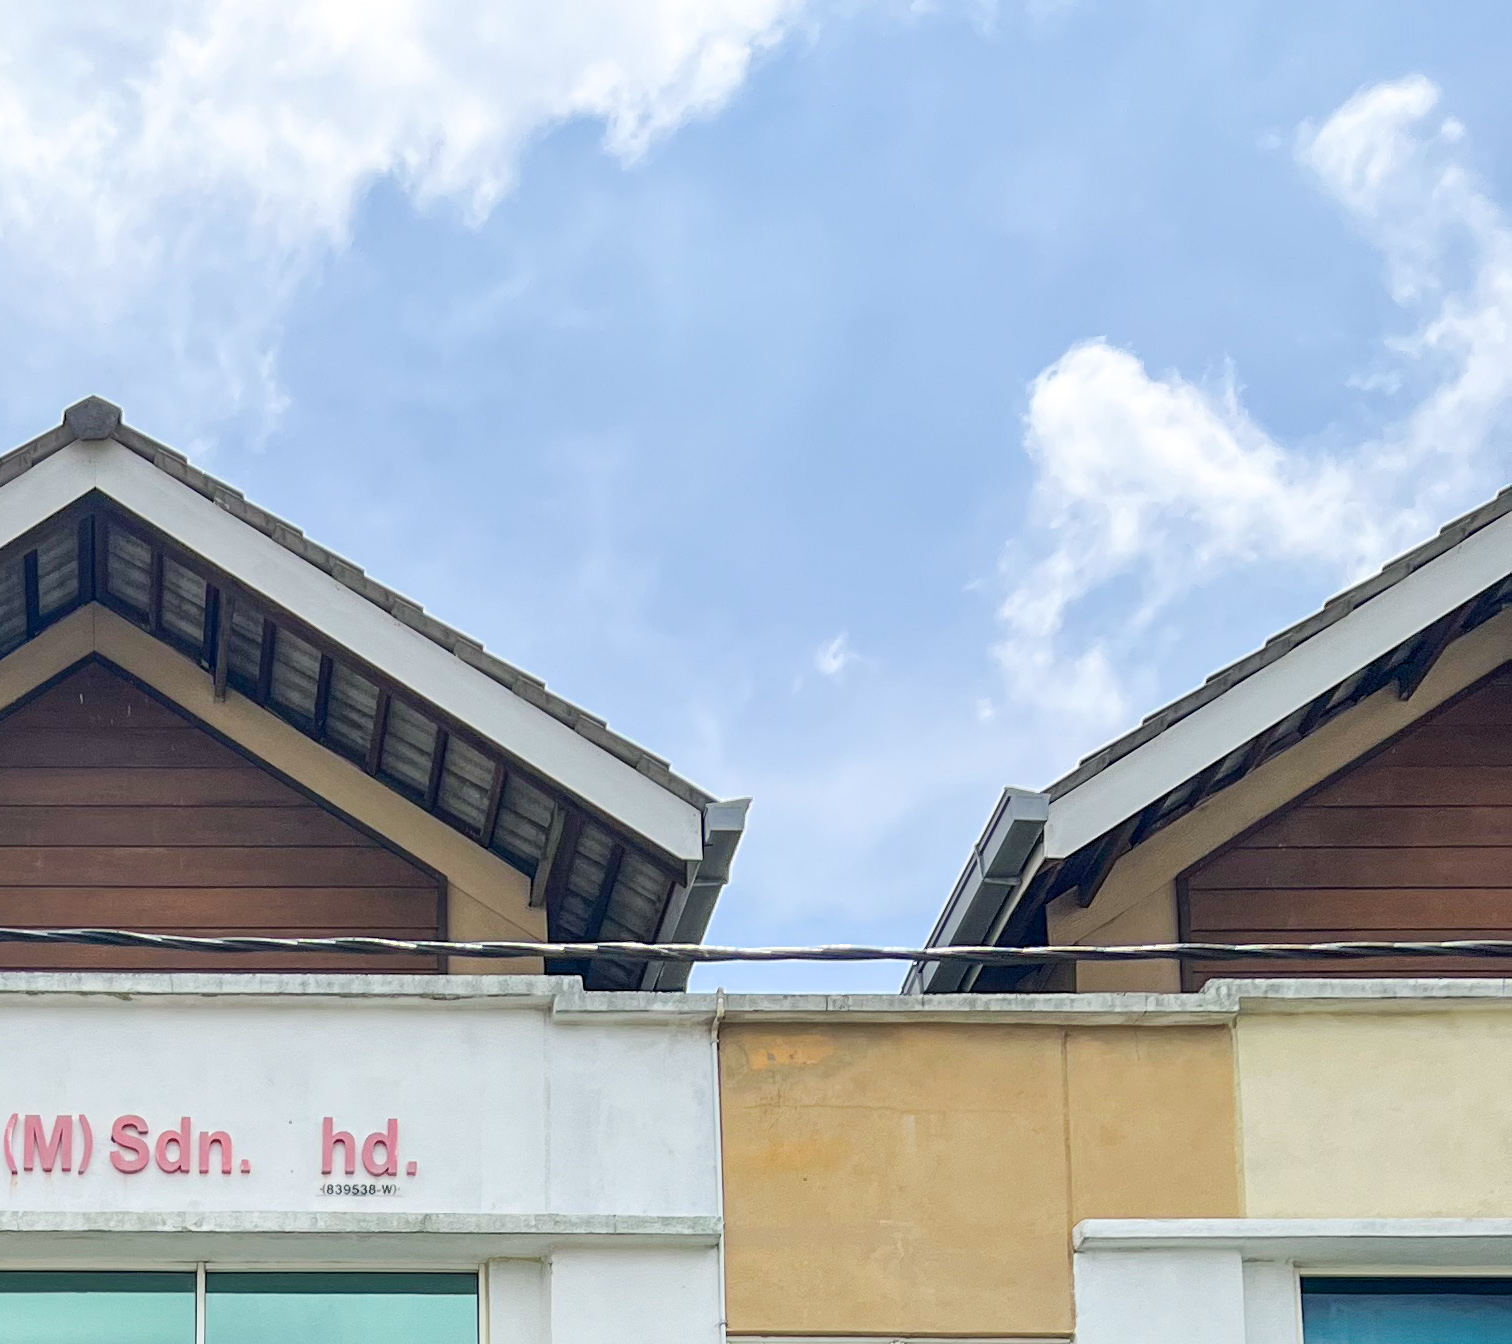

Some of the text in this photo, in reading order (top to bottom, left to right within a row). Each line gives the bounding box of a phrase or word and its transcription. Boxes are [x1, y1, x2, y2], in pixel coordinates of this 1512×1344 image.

[3, 1112, 94, 1176] (M)
[109, 1114, 251, 1175] Sdn.
[322, 1183, 397, 1196] (839538-W)
